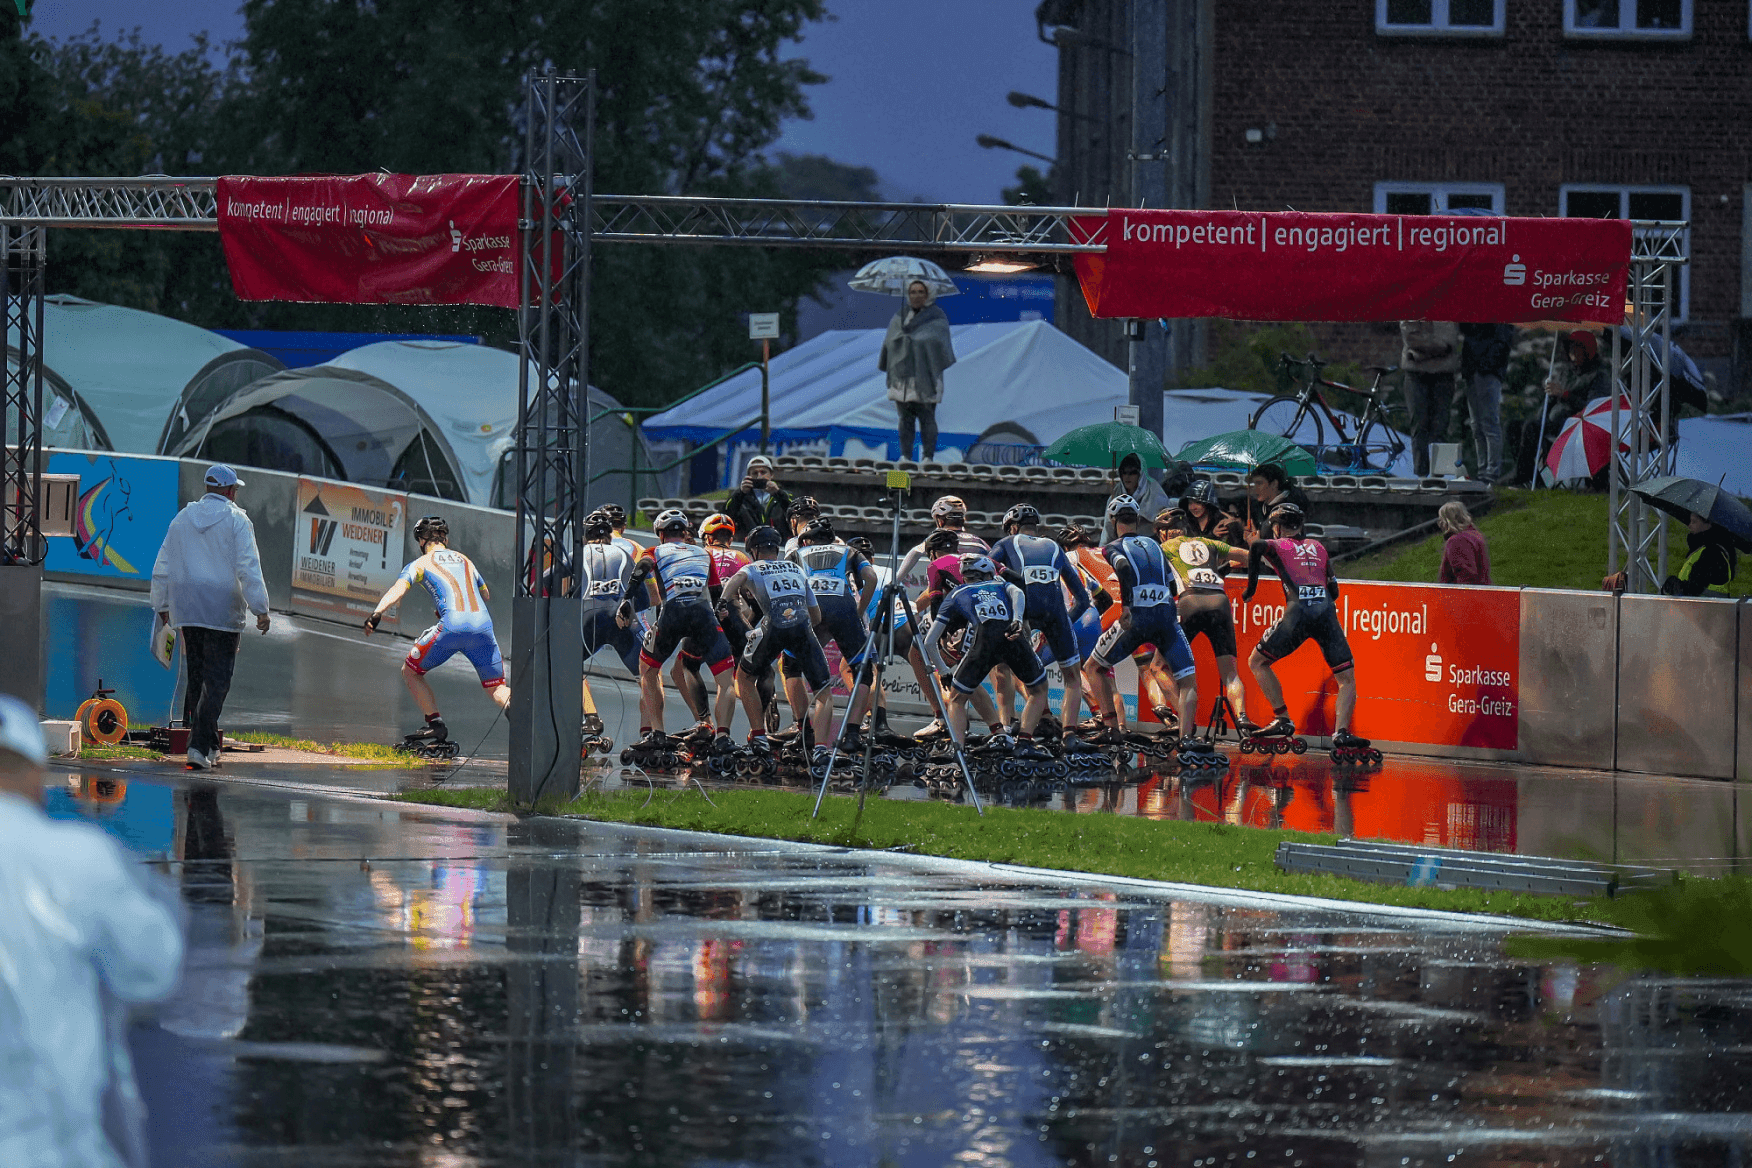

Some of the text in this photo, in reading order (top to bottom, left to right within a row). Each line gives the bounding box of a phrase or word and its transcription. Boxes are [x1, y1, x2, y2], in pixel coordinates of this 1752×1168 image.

[227, 196, 282, 222] kompetent
[292, 202, 340, 226] engagiert
[462, 234, 510, 251] Sparkasse
[1123, 216, 1506, 252] kompetent engagiert regional
[472, 256, 514, 274] Gera-Greiz
[1533, 269, 1610, 288] Sparkasse
[1531, 290, 1611, 308] Gera-Greiz
[301, 556, 335, 573] WEIDENER
[758, 561, 799, 571] SPARTA
[1029, 568, 1055, 581] 451
[1195, 572, 1217, 584] 432
[772, 578, 800, 592] 454
[811, 580, 839, 591] 437
[1299, 586, 1324, 598] 447
[979, 603, 1007, 617] 446
[1353, 603, 1427, 640] regional
[1099, 623, 1117, 648] 444
[1449, 664, 1511, 688] Sparkasse
[1448, 693, 1512, 717] Gera-Greiz
